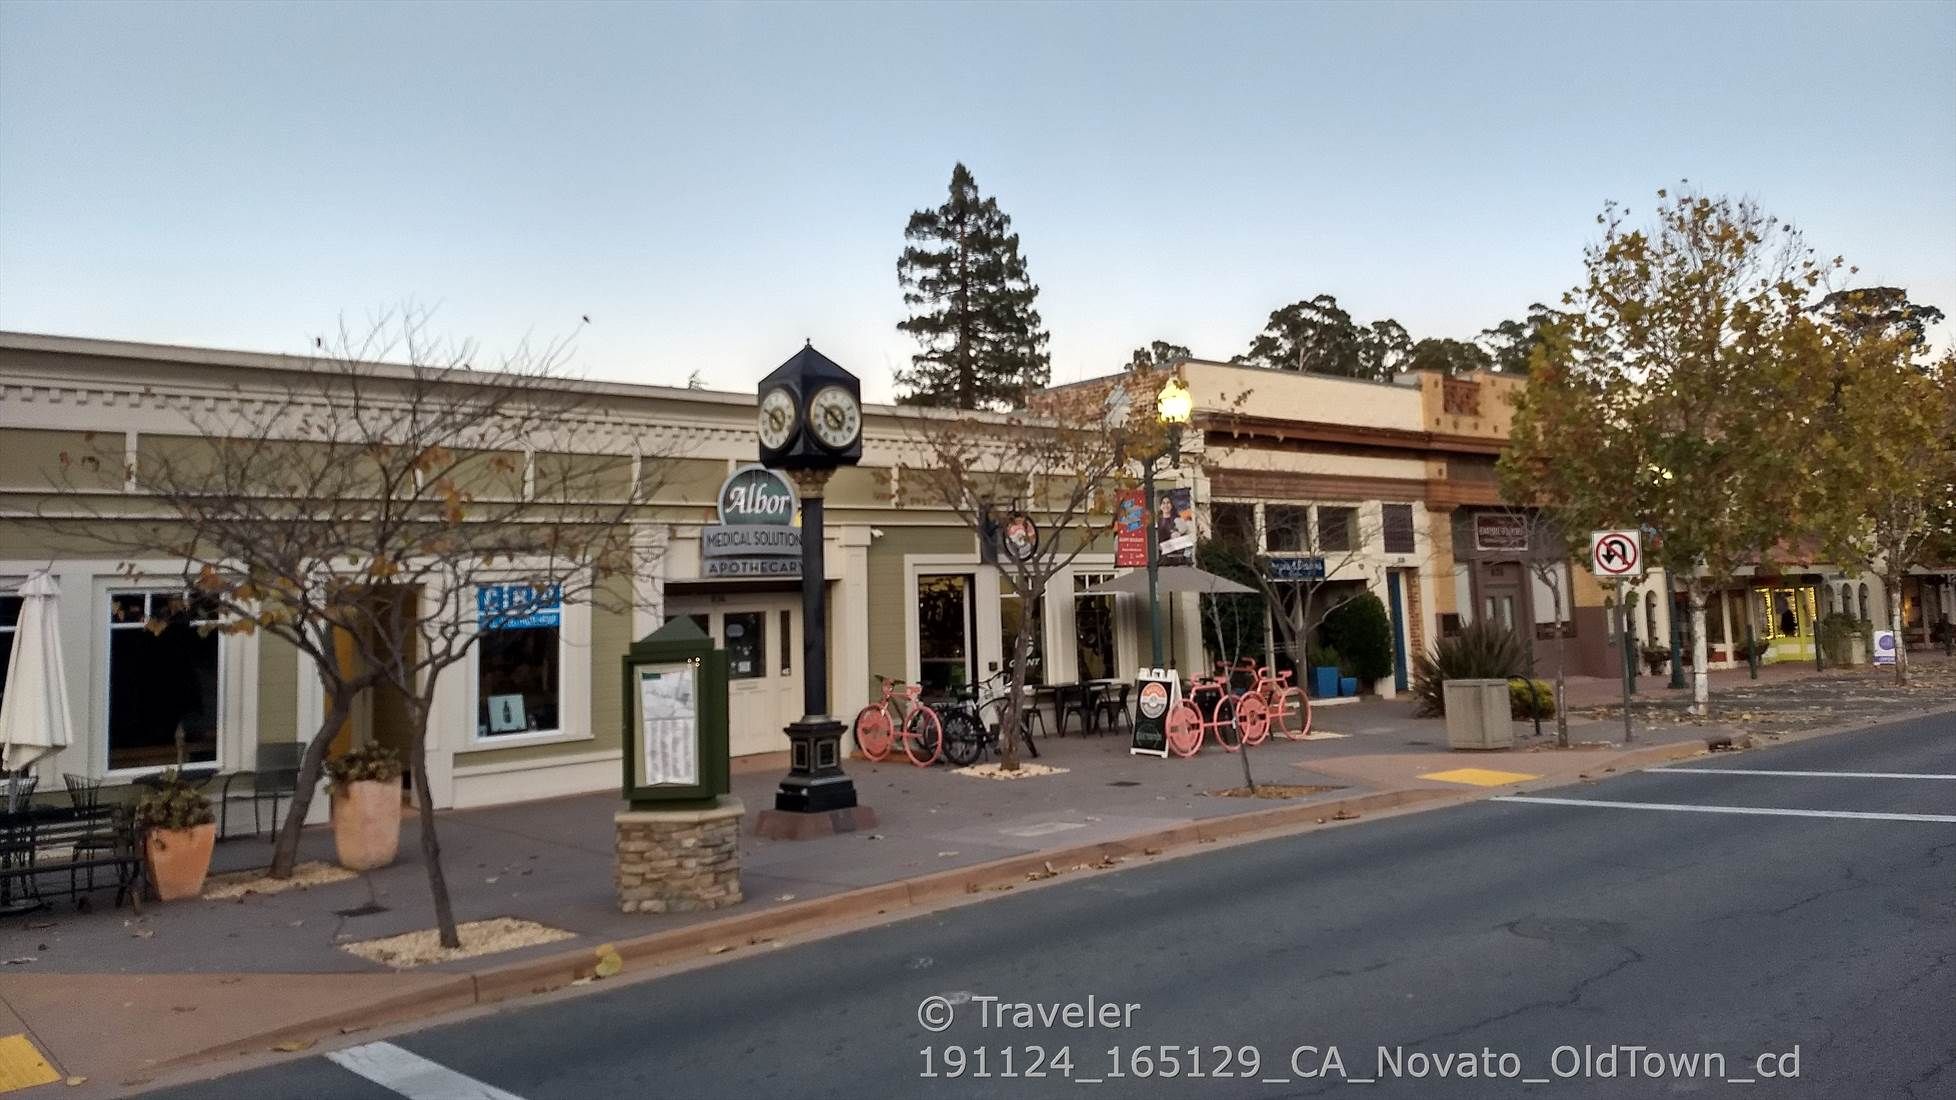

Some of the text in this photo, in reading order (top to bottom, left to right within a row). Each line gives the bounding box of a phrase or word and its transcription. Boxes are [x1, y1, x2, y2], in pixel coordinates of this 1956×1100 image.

[725, 482, 791, 515] Albor
[707, 531, 752, 548] MEDICAL
[709, 561, 802, 574] APOTHECAR
